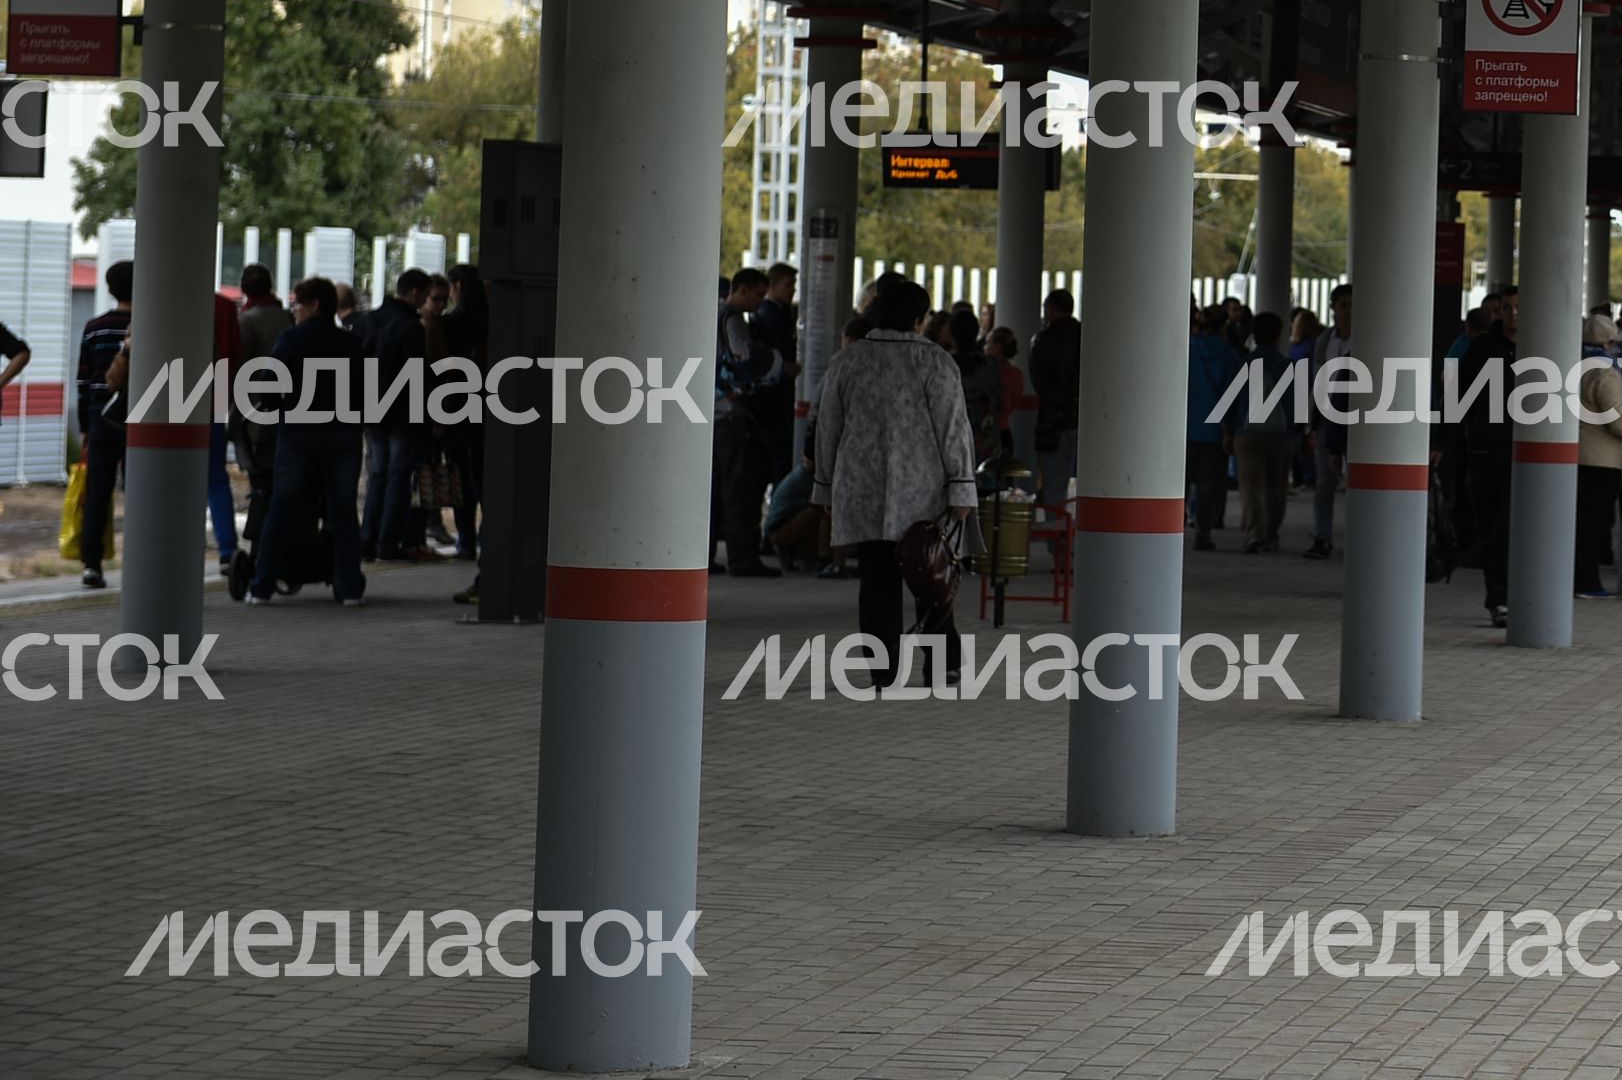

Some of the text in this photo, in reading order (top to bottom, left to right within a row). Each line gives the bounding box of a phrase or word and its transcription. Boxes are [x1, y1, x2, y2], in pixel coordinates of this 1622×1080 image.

[19, 21, 70, 36] Прыгать
[19, 37, 101, 52] с платформы
[19, 52, 90, 65] запрещено!
[1475, 59, 1528, 74] Прыгать
[1486, 74, 1559, 90] платформы
[1474, 91, 1548, 103] запрещено!
[1458, 159, 1473, 180] 2
